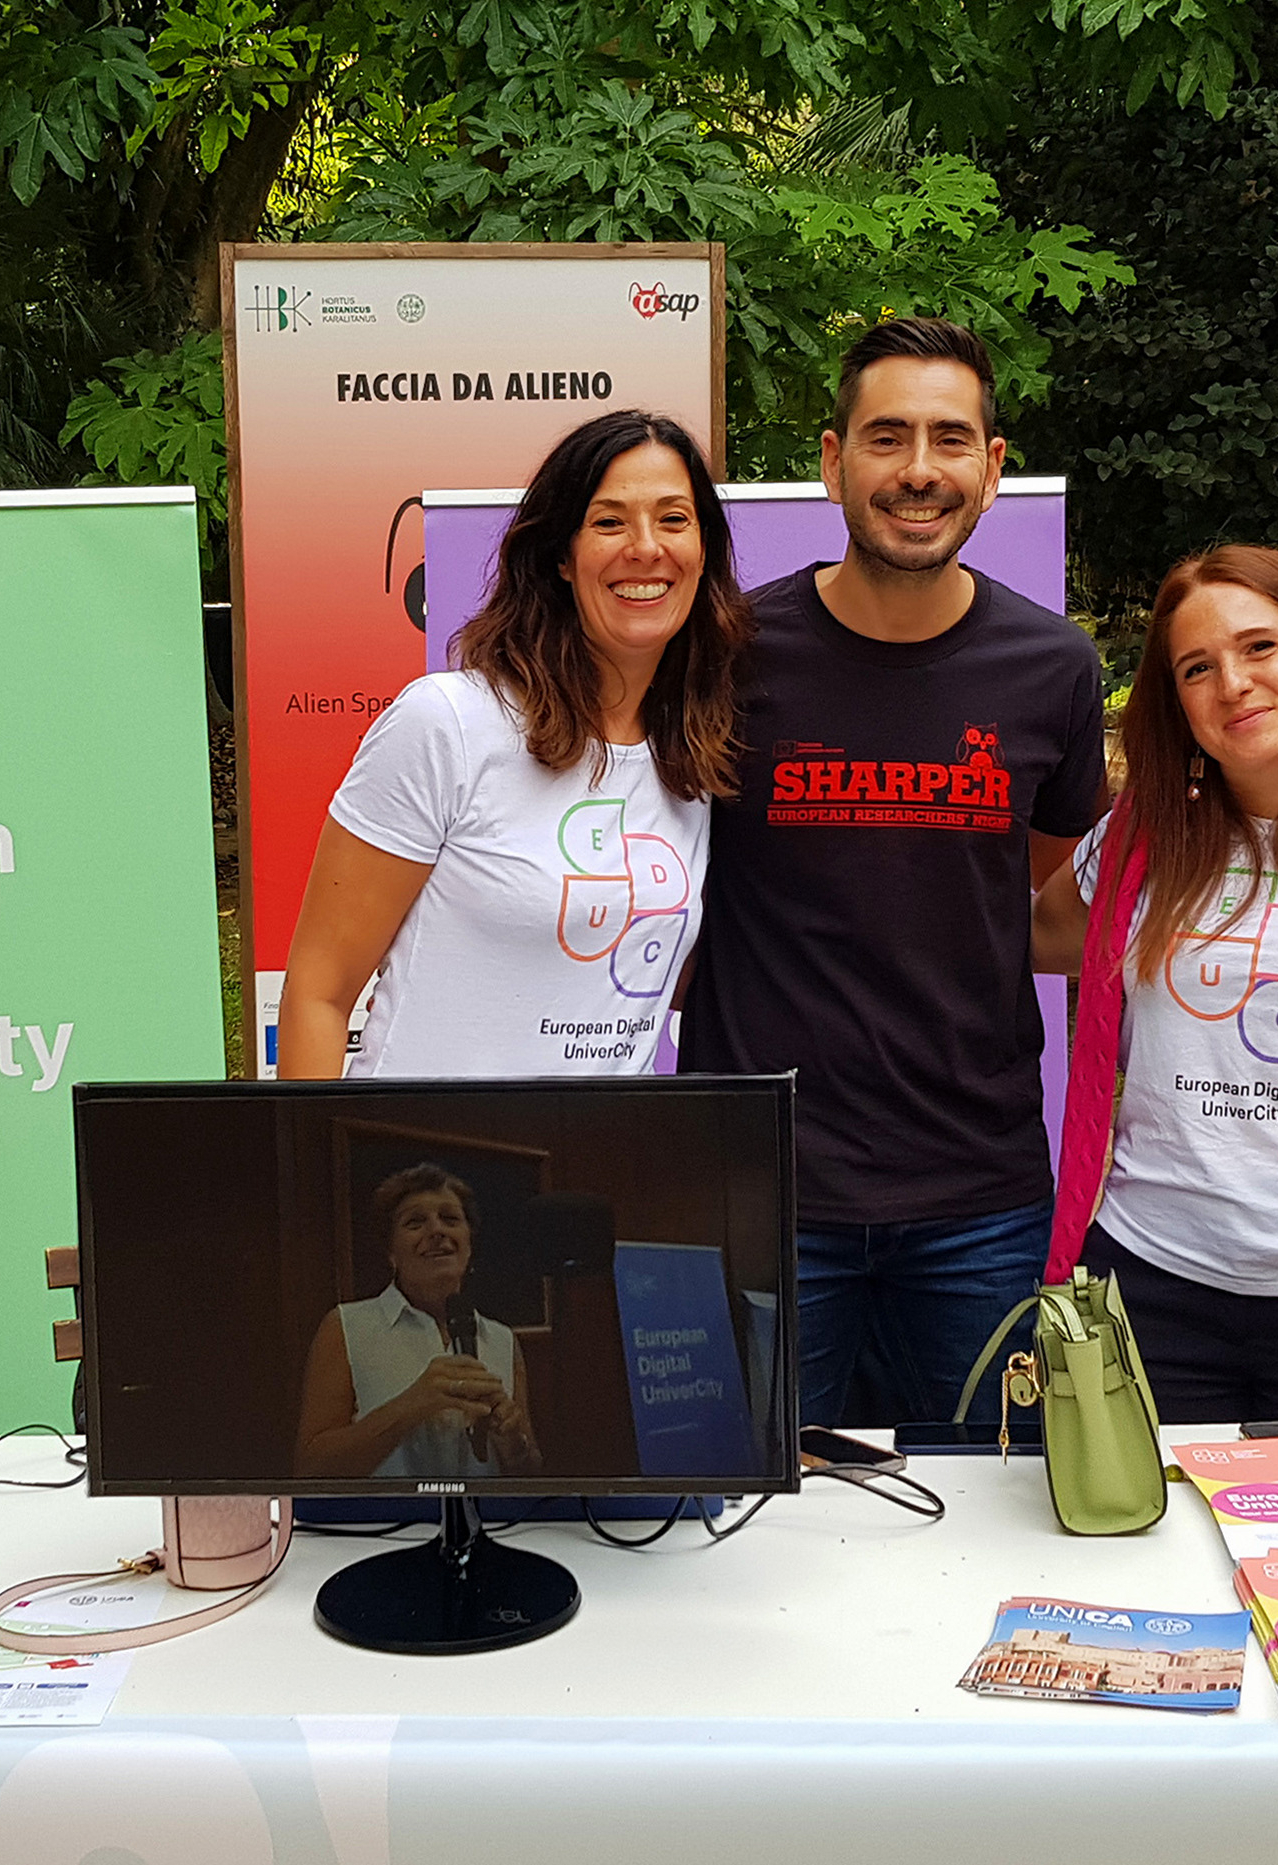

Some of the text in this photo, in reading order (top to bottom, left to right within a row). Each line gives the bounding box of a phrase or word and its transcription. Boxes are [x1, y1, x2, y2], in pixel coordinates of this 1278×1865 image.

[322, 314, 377, 323] KARALITANUS
[638, 293, 699, 321] asap
[337, 371, 613, 402] FACCIA DA ALIENO
[286, 692, 345, 714] Alien
[773, 761, 1011, 808] SHARPER
[767, 809, 1012, 829] EUROPEAN RESEARCHERS' NIGHT
[540, 1015, 655, 1038] European Digital
[563, 1042, 636, 1059] UniverCity
[1174, 1074, 1250, 1098] European
[634, 1328, 708, 1348] European
[637, 1352, 692, 1378] Digital
[641, 1378, 723, 1405] UniverCity
[417, 1482, 466, 1493] SAMSUNG
[1028, 1603, 1133, 1628] UNICA
